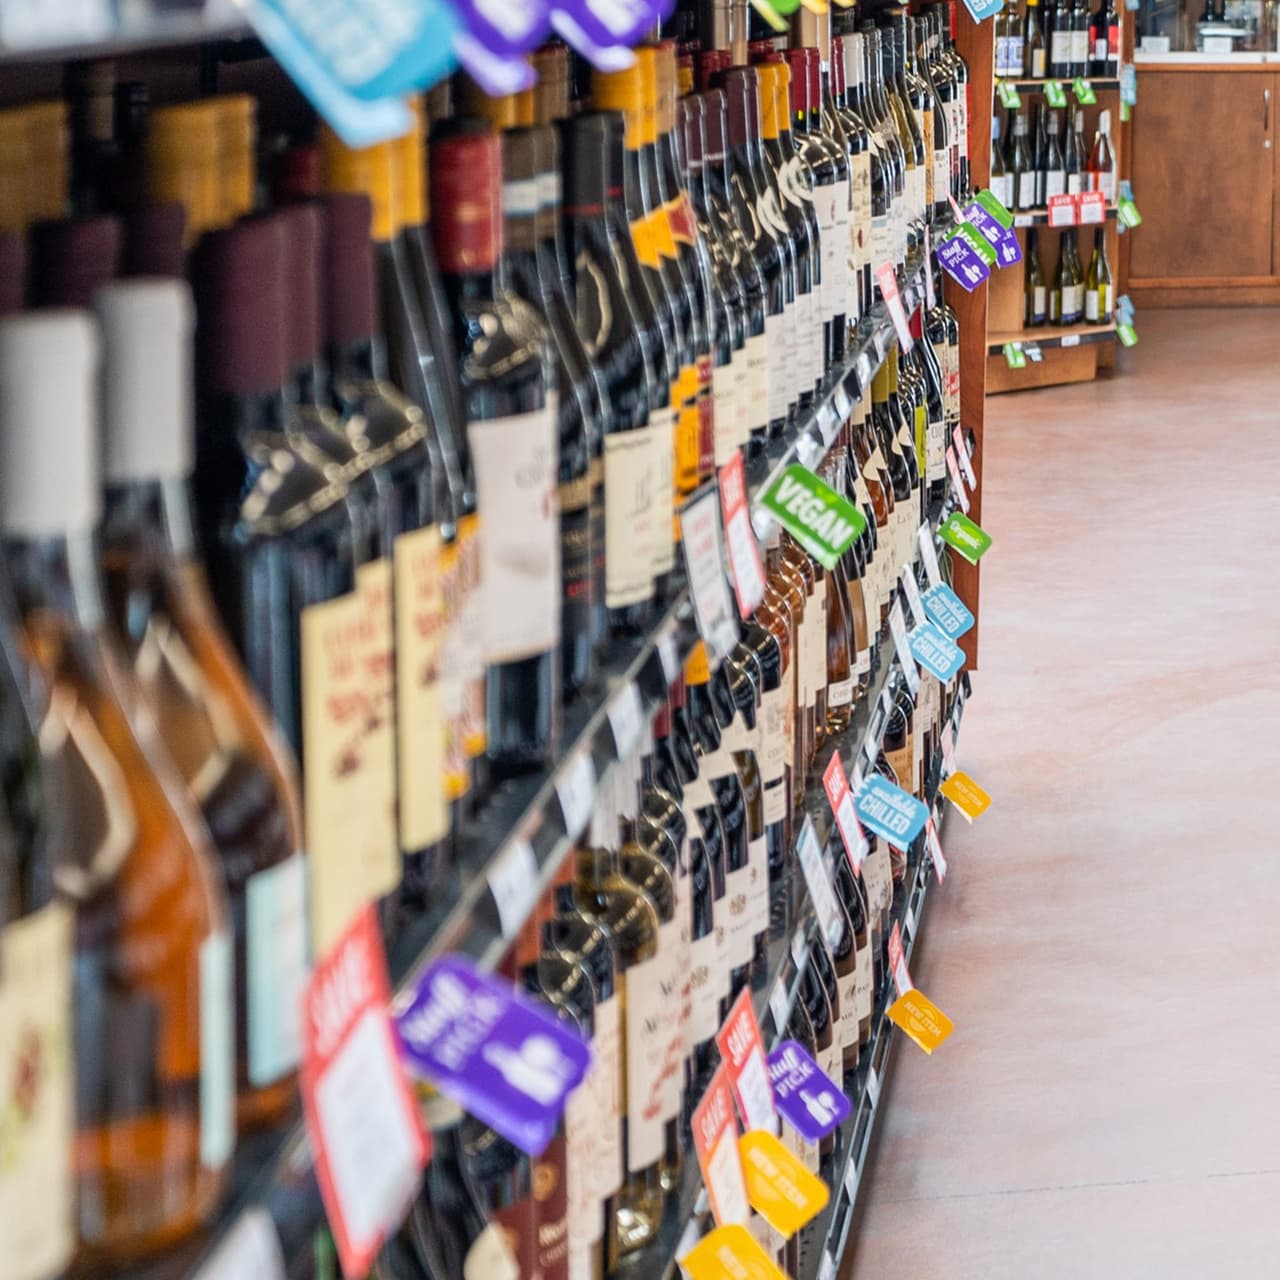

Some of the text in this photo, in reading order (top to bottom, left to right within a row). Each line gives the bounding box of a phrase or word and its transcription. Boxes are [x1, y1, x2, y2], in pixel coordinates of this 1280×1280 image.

[942, 240, 963, 261] Staff
[948, 249, 970, 268] PICK
[957, 226, 991, 264] VEGAN
[775, 475, 853, 543] VEGAN
[925, 596, 959, 632] CHILLED
[912, 636, 950, 674] CHILLED
[858, 796, 911, 836] CHILLED
[904, 1001, 942, 1038] NEW ITEM
[775, 1061, 815, 1099] PICK
